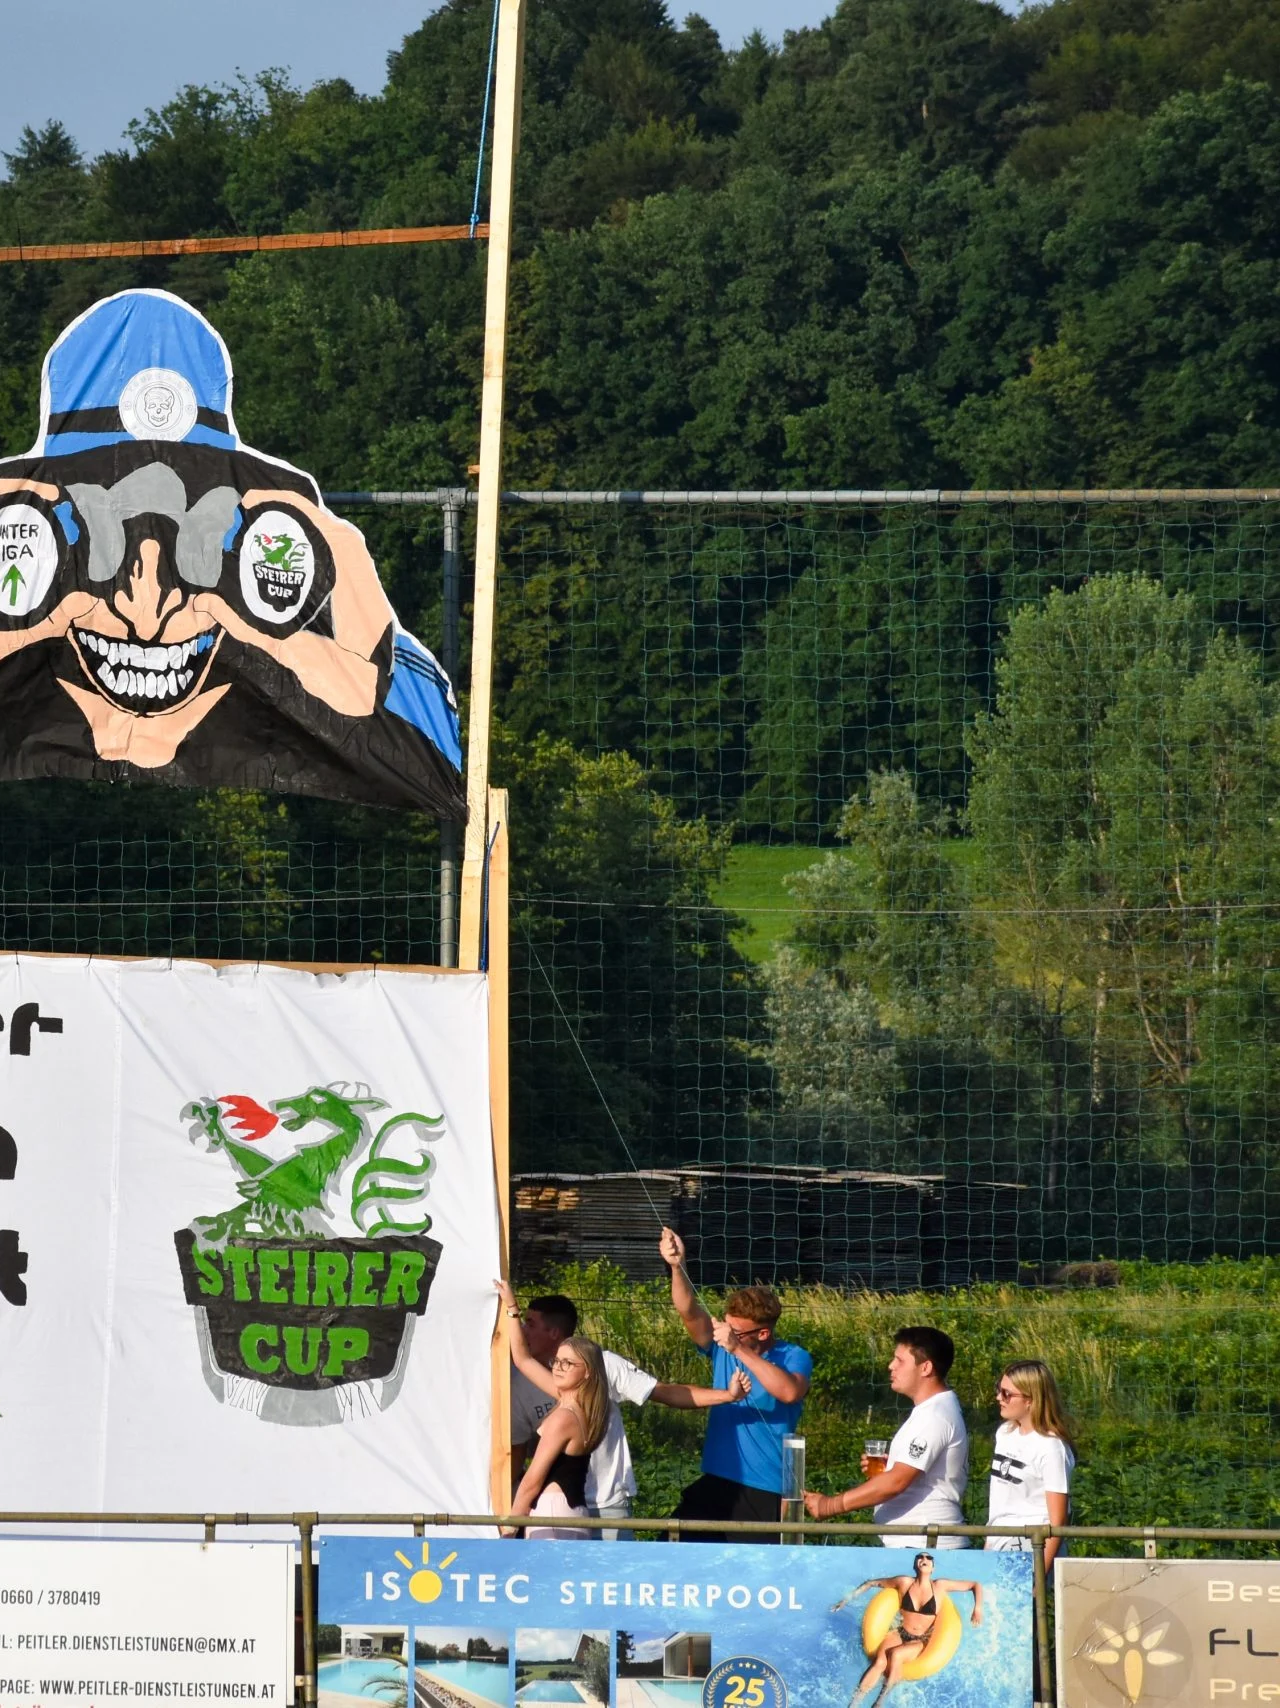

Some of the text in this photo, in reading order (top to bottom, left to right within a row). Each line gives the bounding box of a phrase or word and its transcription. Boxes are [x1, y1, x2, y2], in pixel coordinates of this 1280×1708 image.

[254, 565, 305, 585] STEIRER
[267, 583, 293, 598] CUP
[191, 1241, 426, 1307] STEIRER
[239, 1322, 370, 1377] CUP
[0, 1588, 33, 1605] 0660
[47, 1590, 101, 1606] 3780419
[559, 1580, 803, 1610] STEIRERPOOL
[17, 1634, 256, 1654] PEITLER.DIENSTLEISTUNGEN@GMX.AT
[39, 1679, 276, 1699] WWW.PEITLER-DIENSTLEISTUNGEN.AT
[724, 1674, 766, 1707] 25
